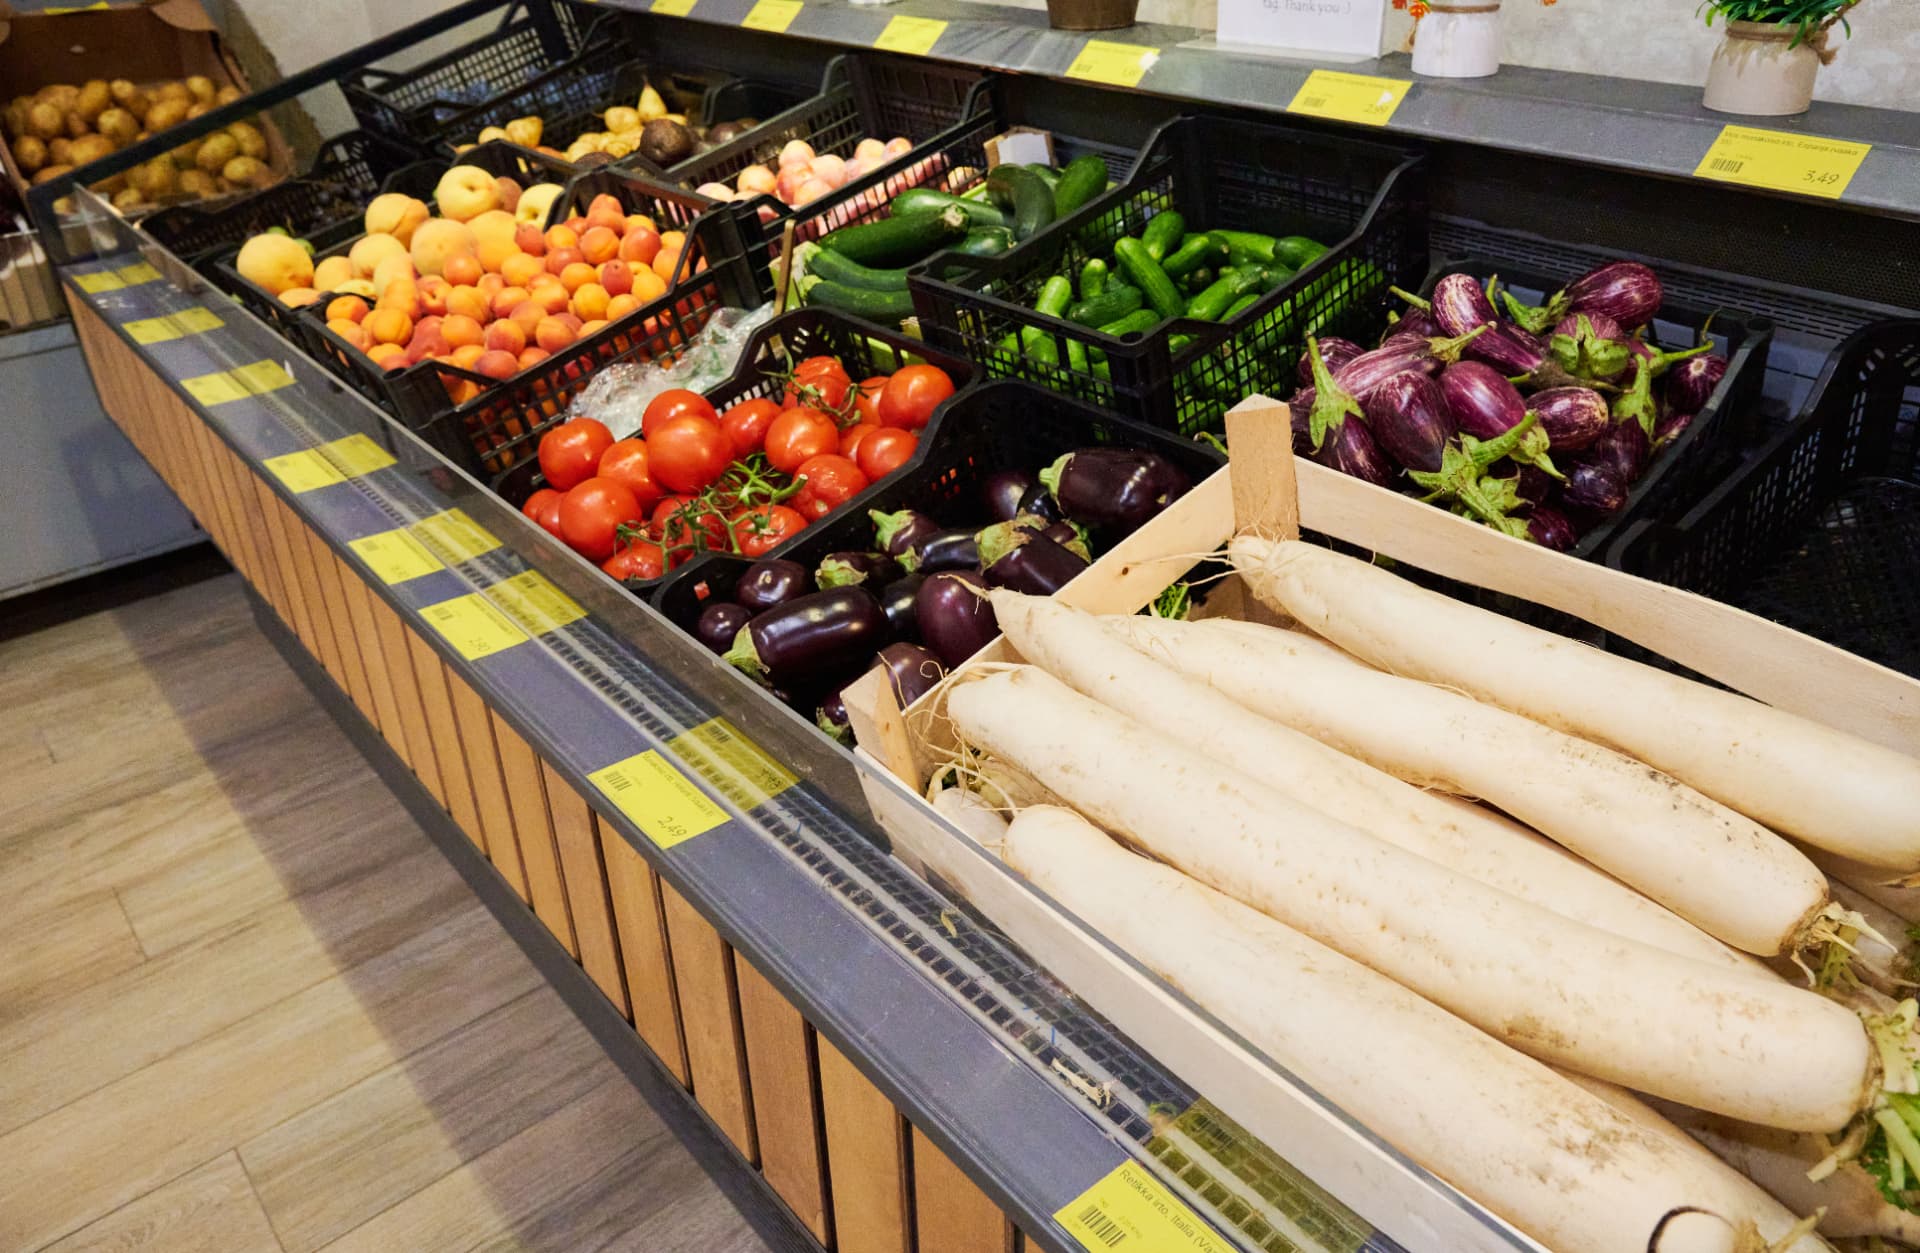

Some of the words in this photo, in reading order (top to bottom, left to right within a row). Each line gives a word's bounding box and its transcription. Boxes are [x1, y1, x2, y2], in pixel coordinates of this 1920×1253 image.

[1317, 3, 1340, 16] you
[1803, 169, 1840, 185] 3,49
[657, 816, 687, 837] 2,49
[1120, 1169, 1153, 1201] Retikka
[1170, 1215, 1195, 1238] Italia
